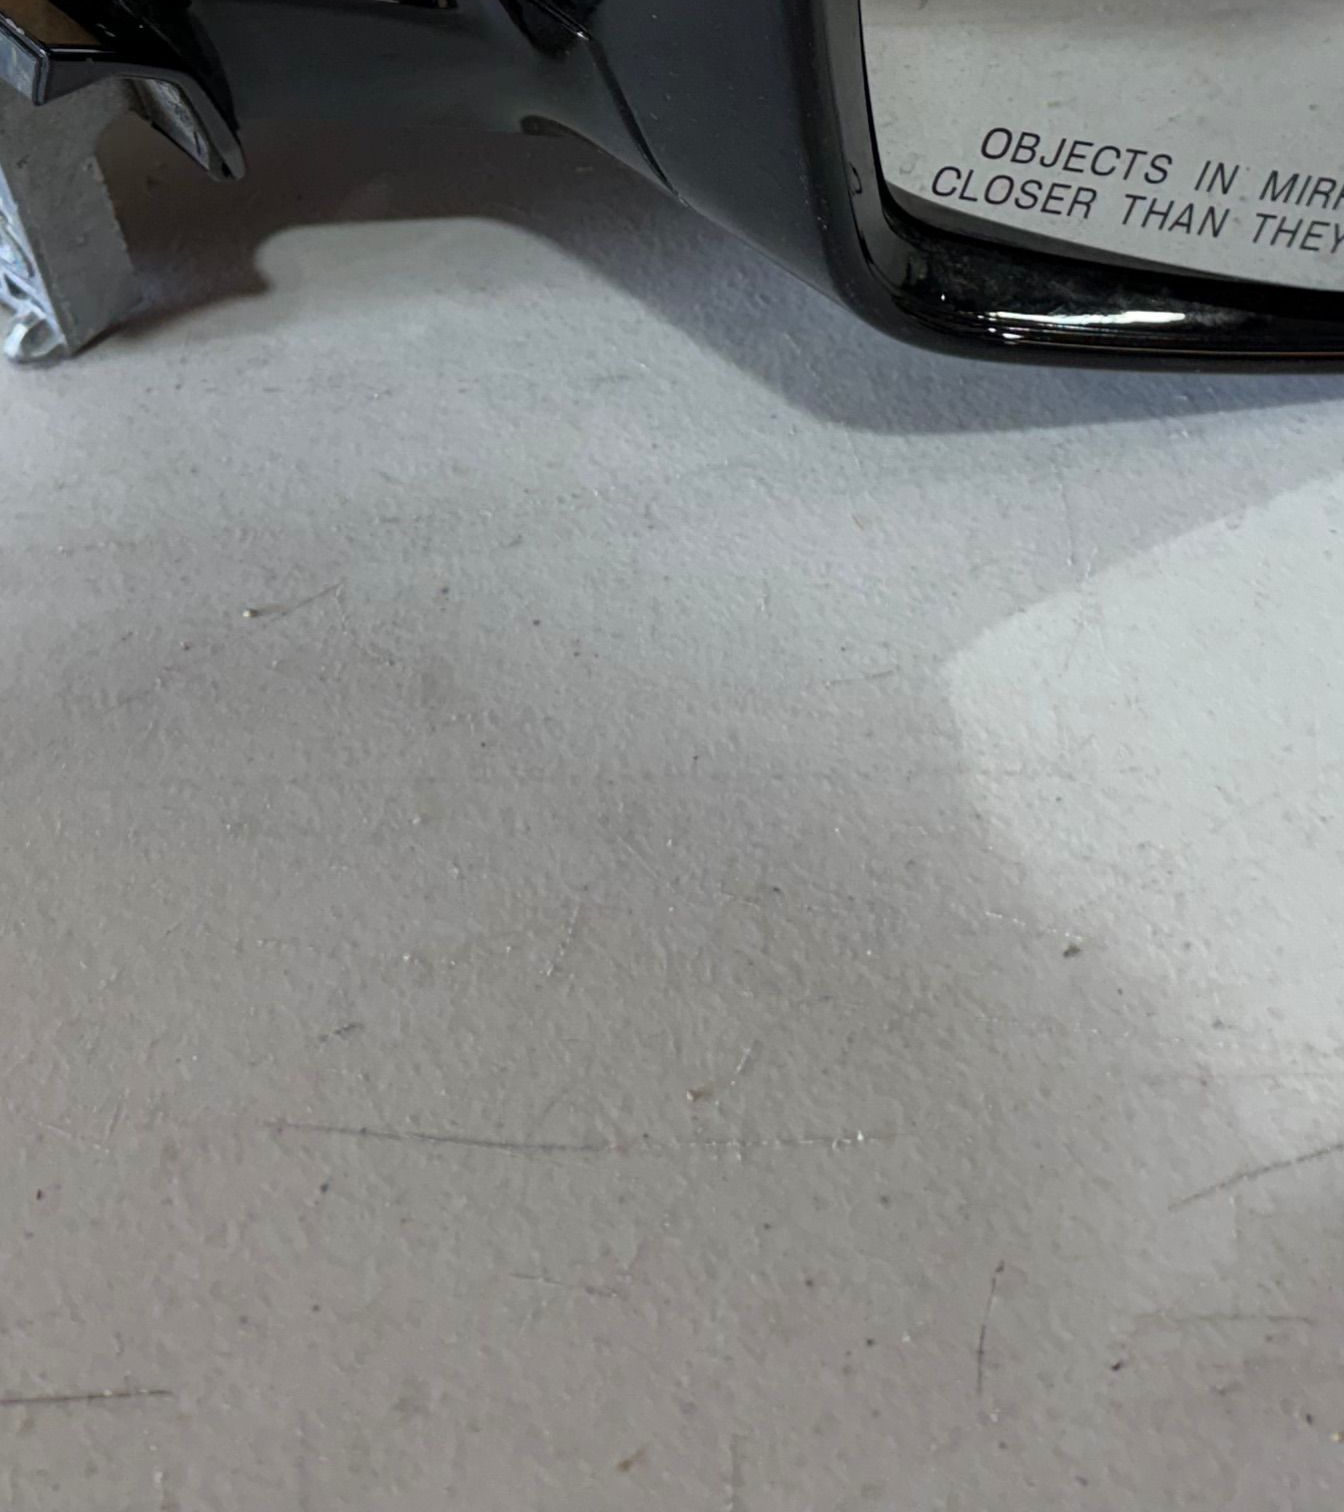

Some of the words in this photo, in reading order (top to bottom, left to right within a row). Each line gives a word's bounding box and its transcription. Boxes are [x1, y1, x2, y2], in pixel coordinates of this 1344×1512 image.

[980, 127, 1173, 185] OBJECTS
[1195, 160, 1240, 196] IN
[931, 166, 1098, 219] CLOSER
[1122, 194, 1231, 239] THAN
